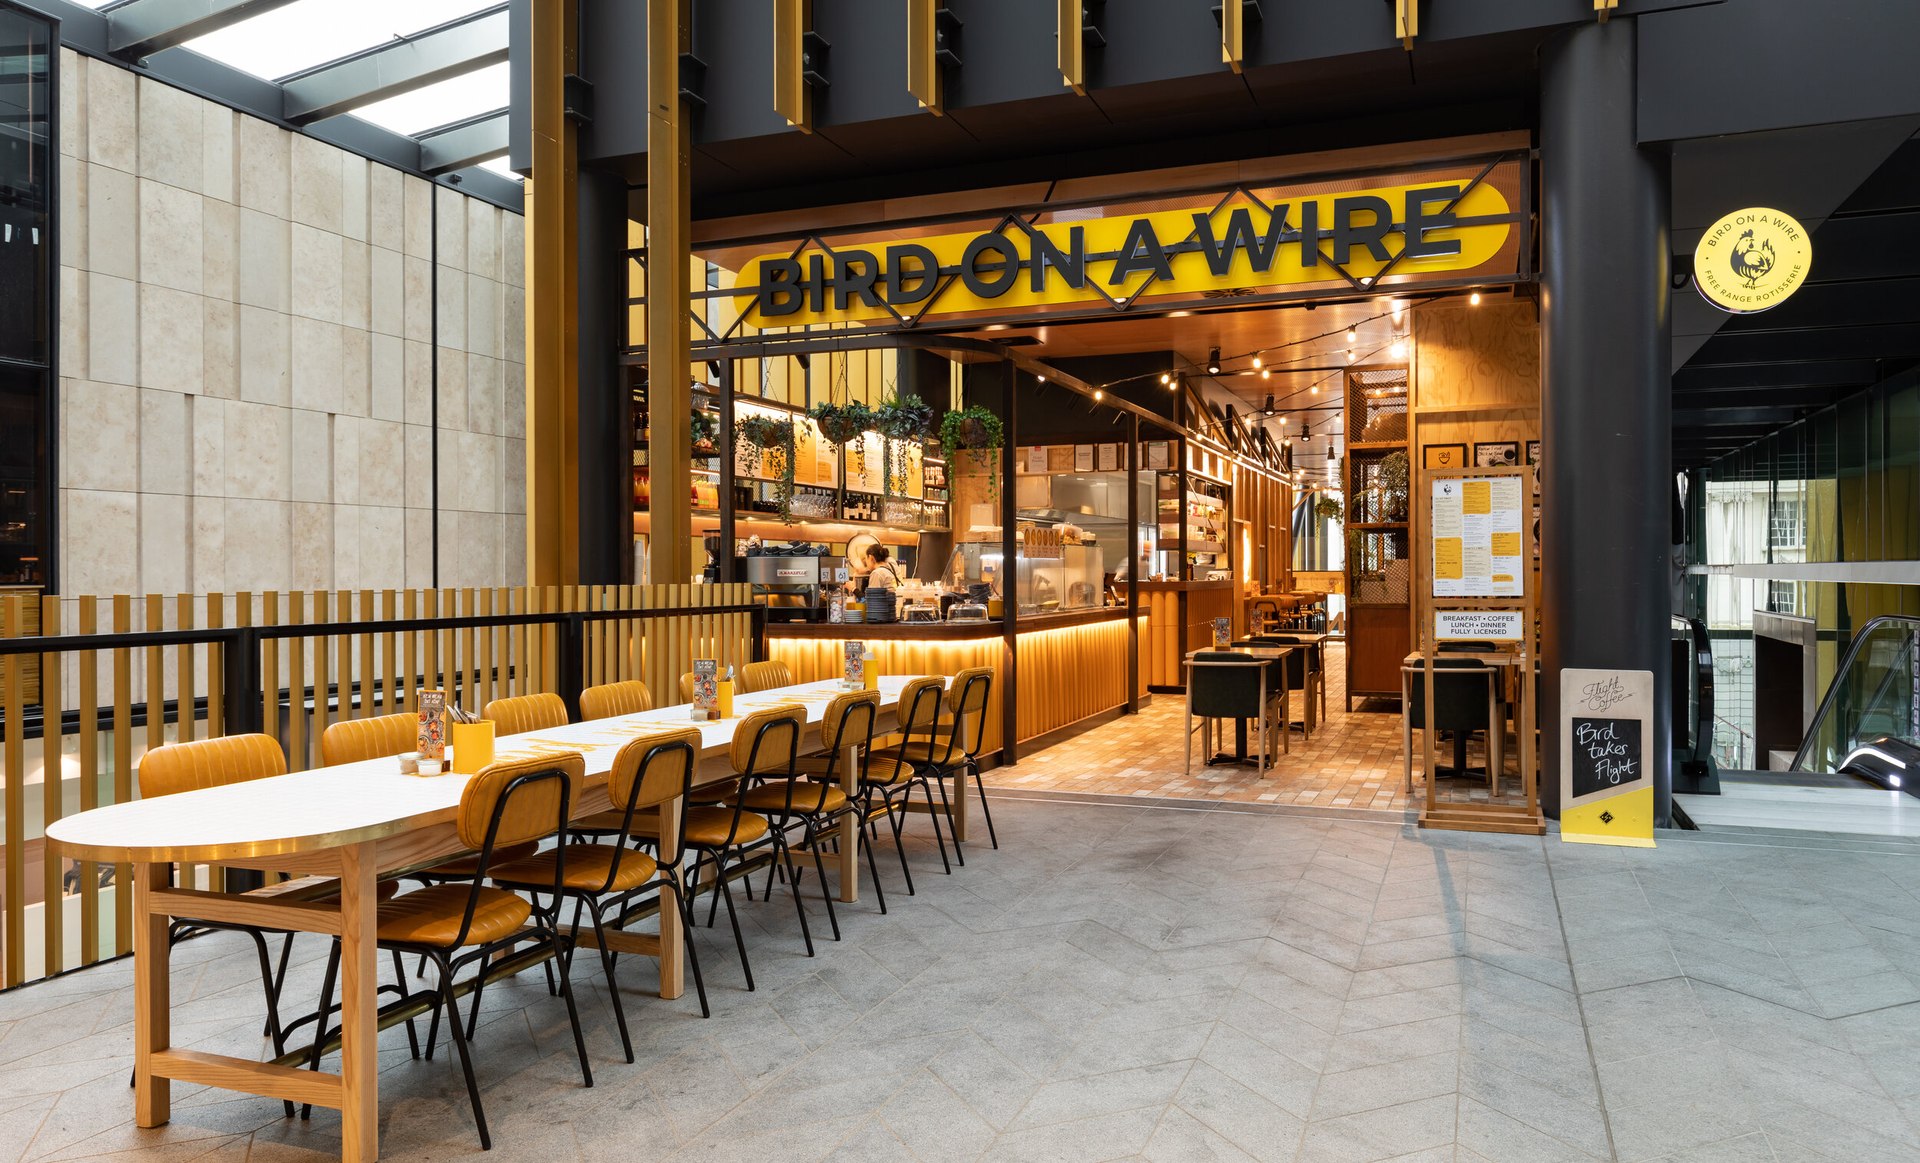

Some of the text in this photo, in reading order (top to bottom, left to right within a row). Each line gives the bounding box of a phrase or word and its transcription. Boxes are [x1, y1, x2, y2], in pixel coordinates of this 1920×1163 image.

[1708, 215, 1799, 247] BIRD ON A WIRE
[759, 185, 1463, 317] BIRD ON A WIRE
[1705, 264, 1801, 303] FREE RANGE ROTISSERIE
[838, 572, 846, 580] 61
[1582, 675, 1625, 698] Flight
[1588, 690, 1634, 713] Coffee
[1576, 722, 1620, 746] Bird
[1587, 741, 1628, 759] takes
[1595, 758, 1638, 784] Flight
